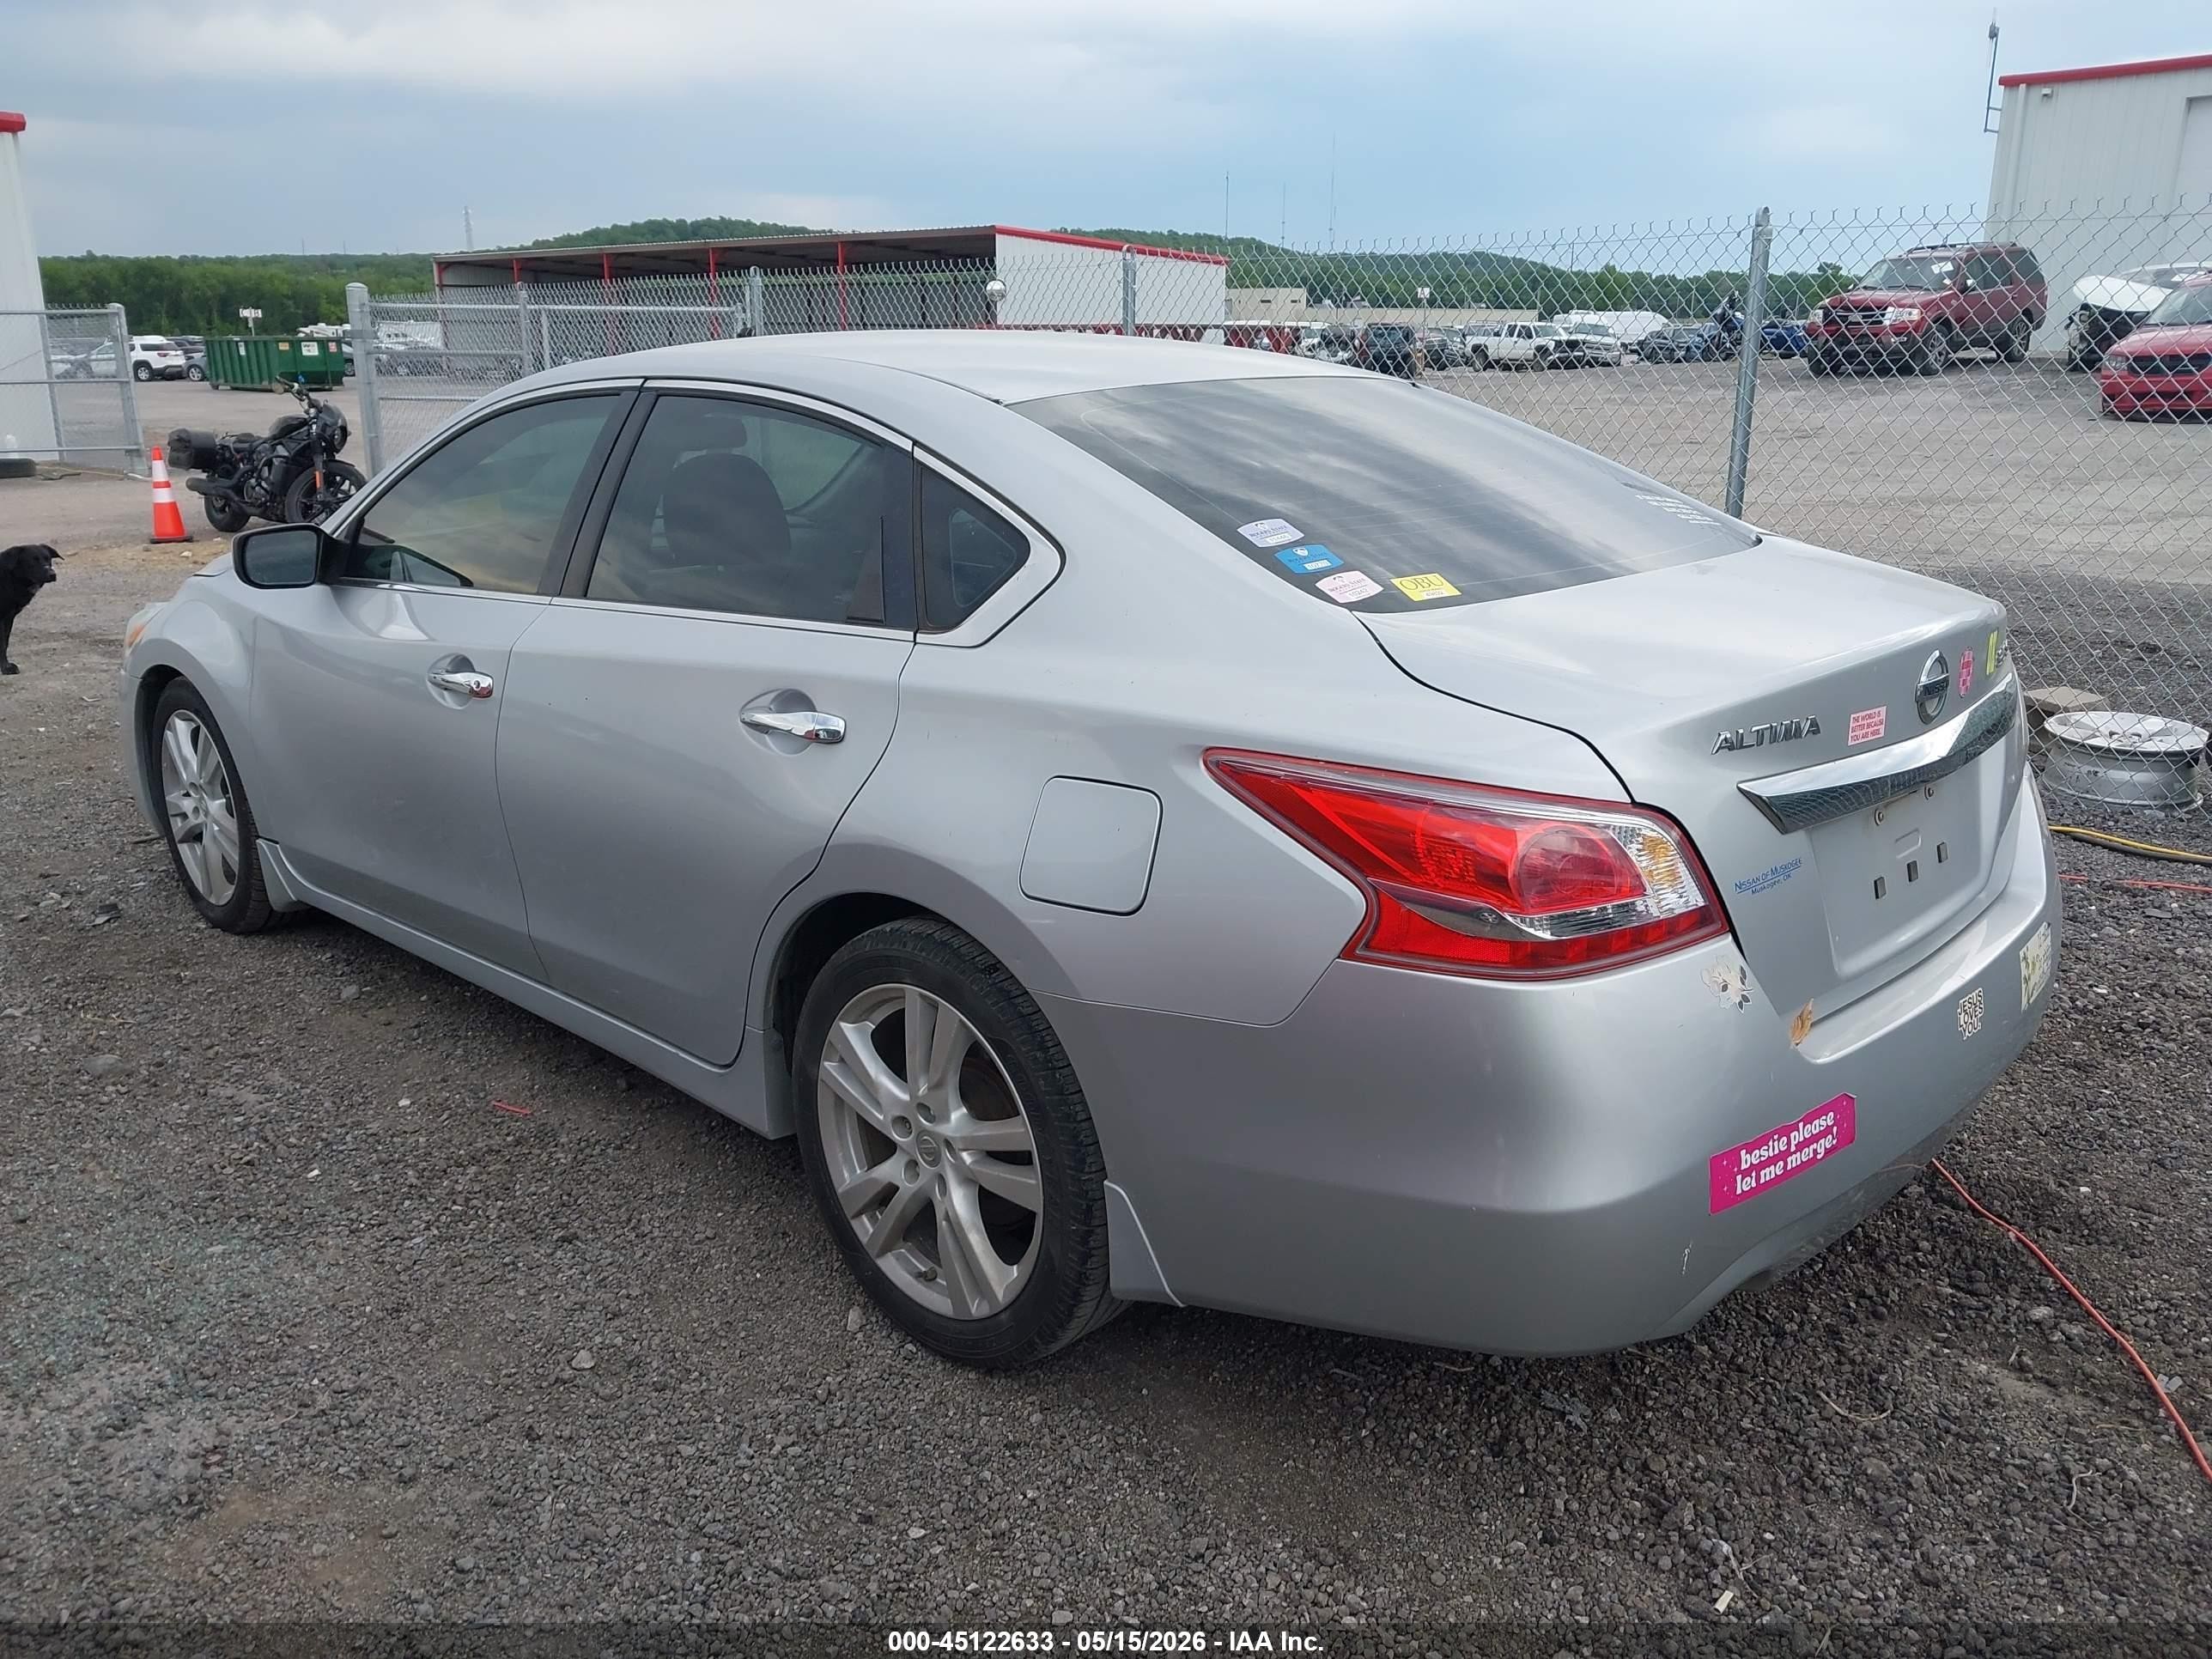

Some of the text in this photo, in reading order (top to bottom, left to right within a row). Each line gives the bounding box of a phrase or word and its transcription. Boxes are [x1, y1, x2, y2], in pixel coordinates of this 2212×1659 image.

[1400, 574, 1444, 591] OBU
[1850, 718, 1884, 733] BETTER BECAUSE
[1861, 711, 1876, 721] WORLD
[1711, 715, 1821, 755] ALTIMA
[1850, 733, 1861, 743] YOU
[1735, 858, 1802, 892] NISSAN OF MUSKOGEE
[1783, 872, 1792, 881] OK
[1959, 989, 1983, 1016] JESUS
[1959, 1002, 1984, 1029] LOVES
[1740, 1111, 1835, 1170] bestie please
[1735, 1126, 1838, 1195] let me merge!
